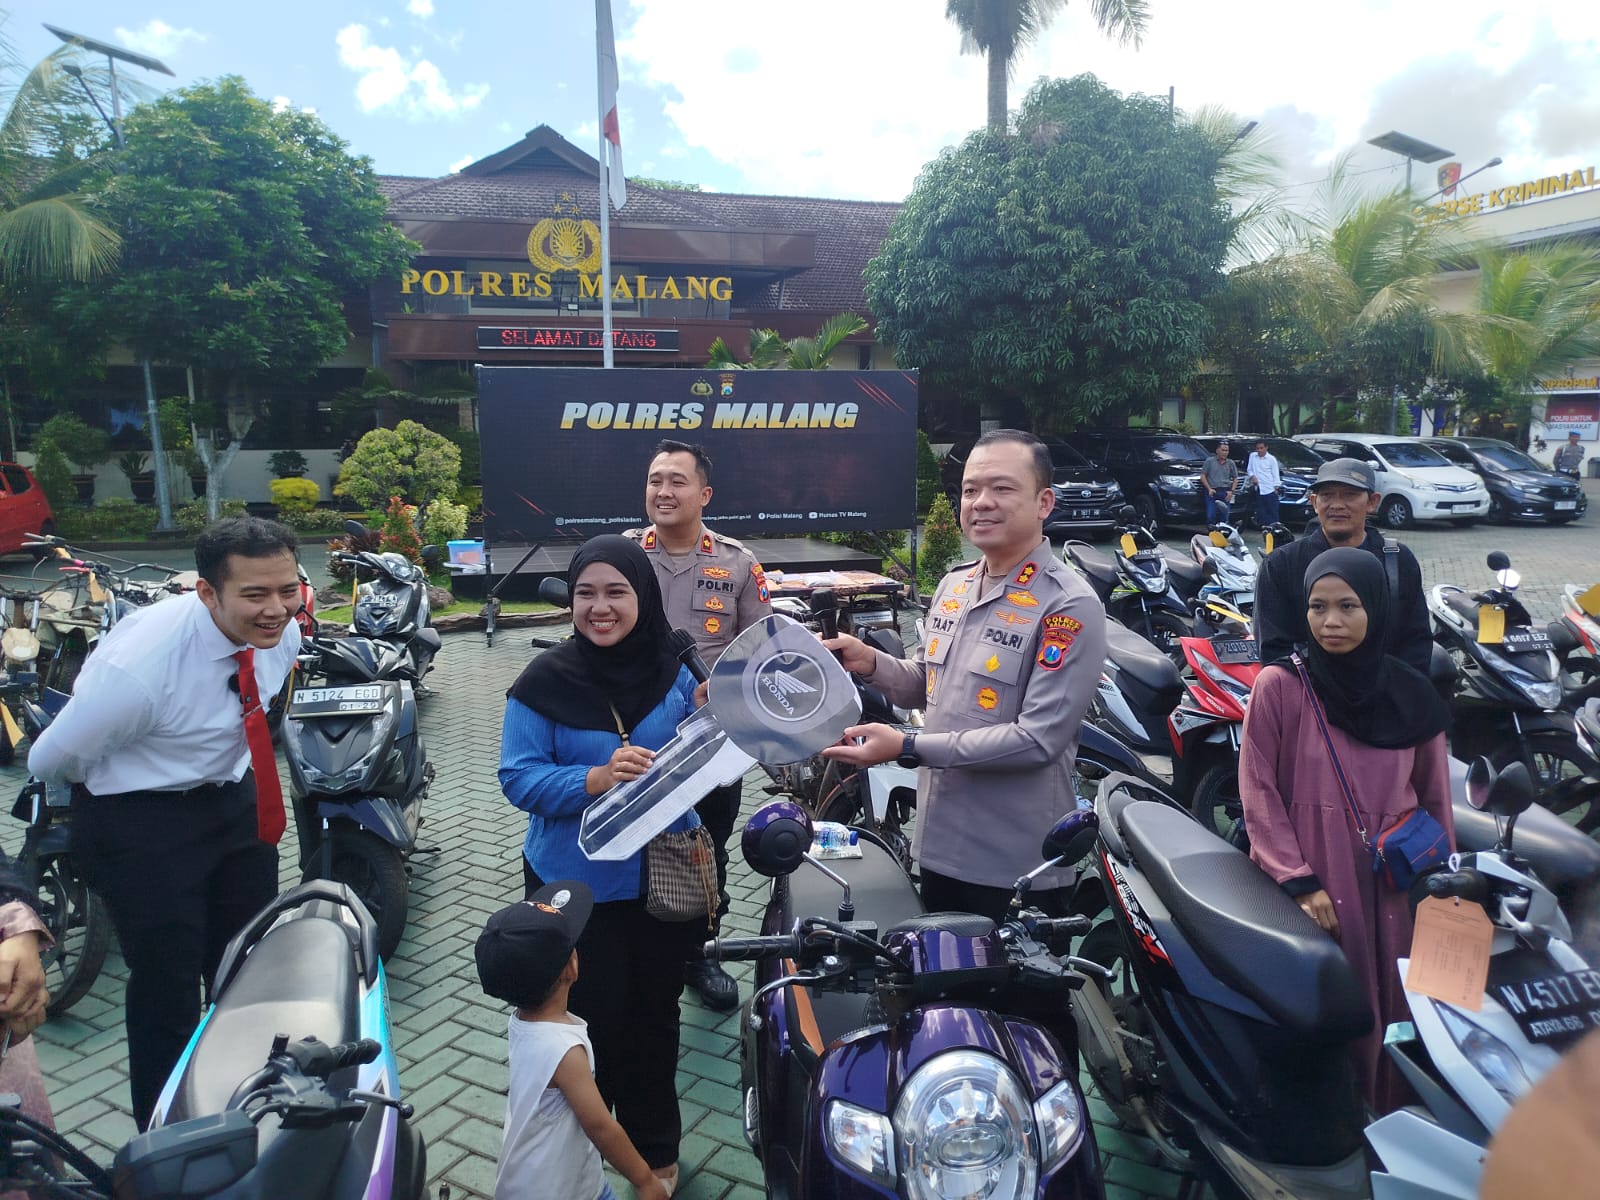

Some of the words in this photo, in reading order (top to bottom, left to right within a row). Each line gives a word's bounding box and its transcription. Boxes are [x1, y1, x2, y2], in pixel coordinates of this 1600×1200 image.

[1487, 166, 1596, 208] KRIMINAL
[399, 269, 553, 298] POLRES
[577, 274, 734, 301] MALANG
[501, 329, 584, 347] SELAMAT
[560, 402, 705, 430] POLRES
[711, 402, 859, 429] MALANG
[783, 512, 803, 520] Malang
[847, 511, 867, 519] Malang
[697, 580, 734, 592] POLRI
[932, 617, 954, 632] TAAT
[1045, 616, 1081, 629] POLRES
[983, 628, 1024, 649] POLRI
[297, 692, 305, 703] N
[312, 690, 344, 702] 5124
[762, 675, 794, 715] HONDA
[1500, 985, 1527, 1014] N
[1523, 975, 1580, 1010] 4517
